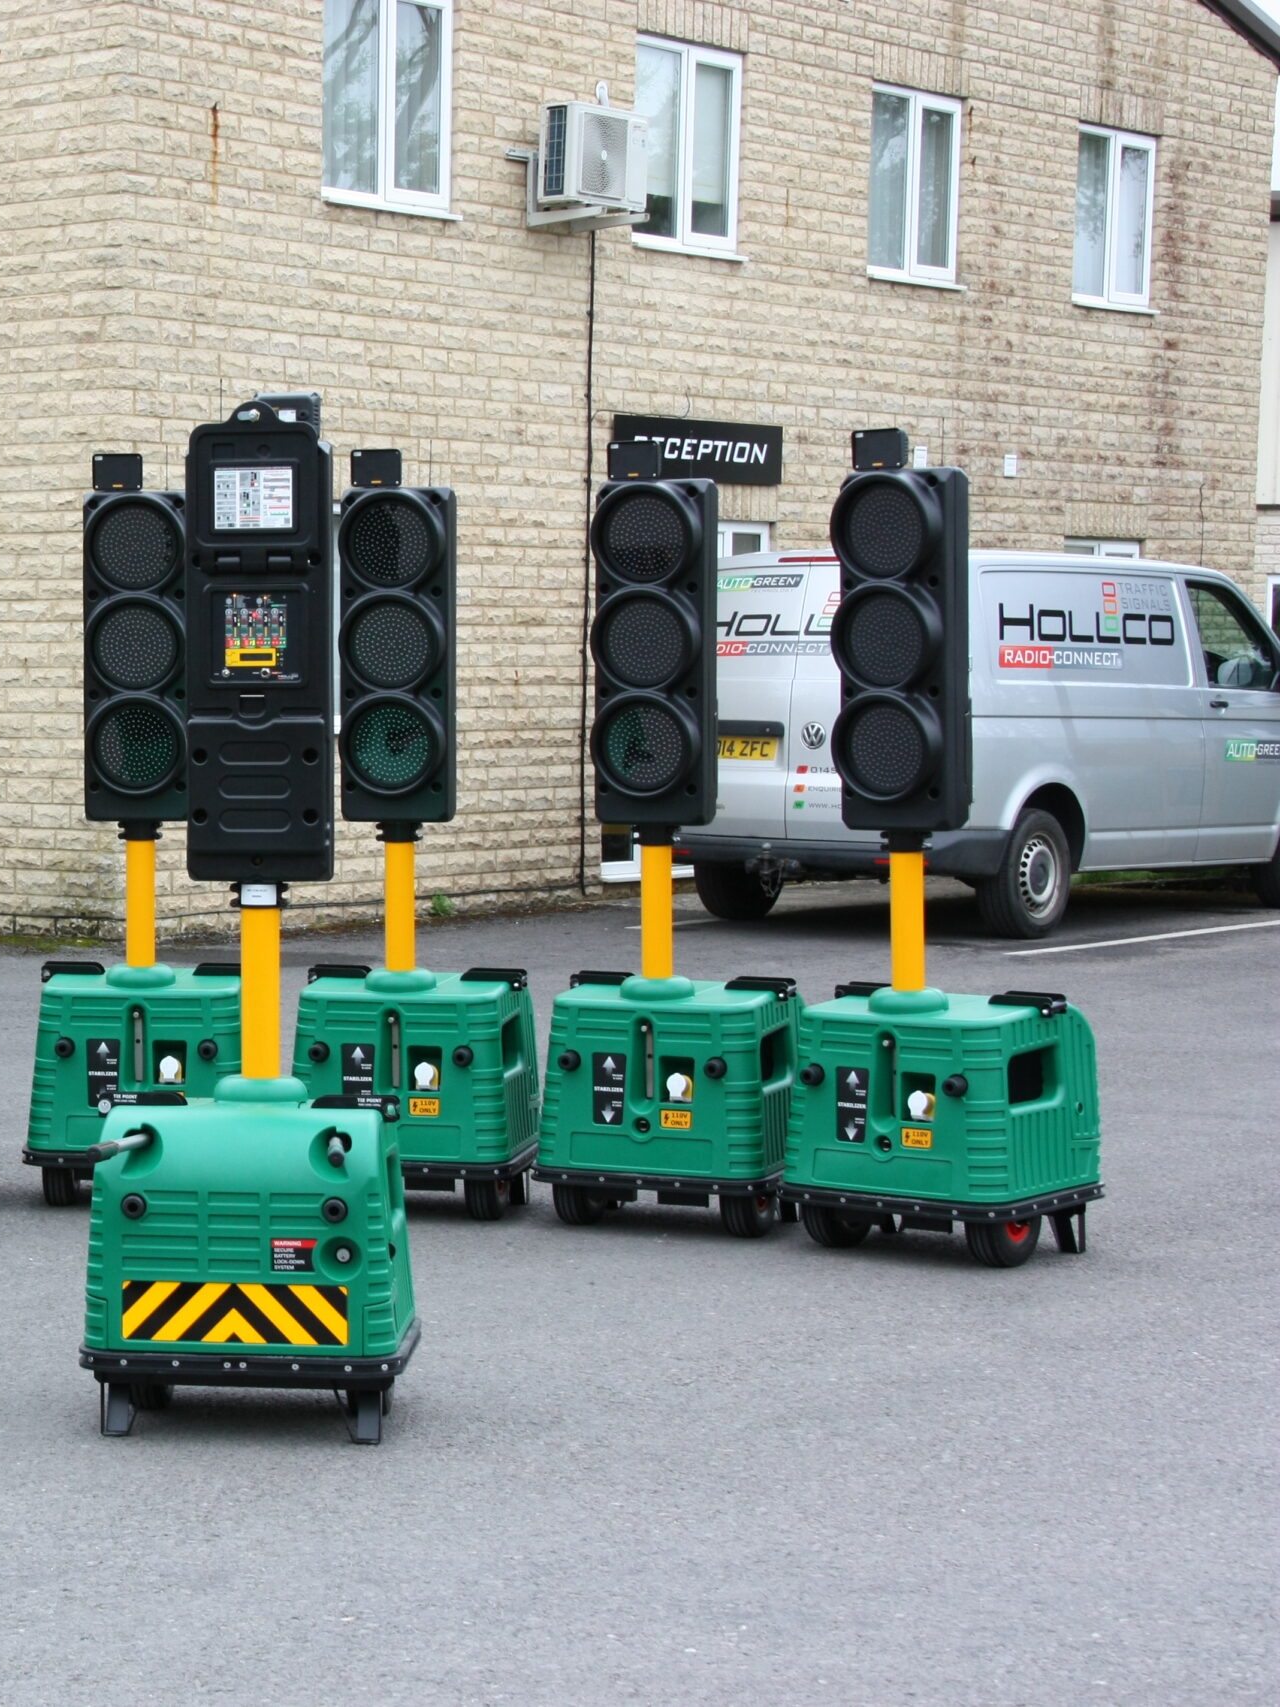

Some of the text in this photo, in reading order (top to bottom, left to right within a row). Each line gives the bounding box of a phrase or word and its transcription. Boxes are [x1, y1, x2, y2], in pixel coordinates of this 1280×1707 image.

[634, 436, 768, 464] CEPTION
[1117, 583, 1168, 597] TRAFFIC
[1121, 597, 1171, 611] SIGNALS
[717, 611, 831, 637] HOLL
[999, 603, 1175, 646] HOLLCO
[717, 643, 827, 654] DIO-CONNECT
[739, 740, 770, 757] ZFC
